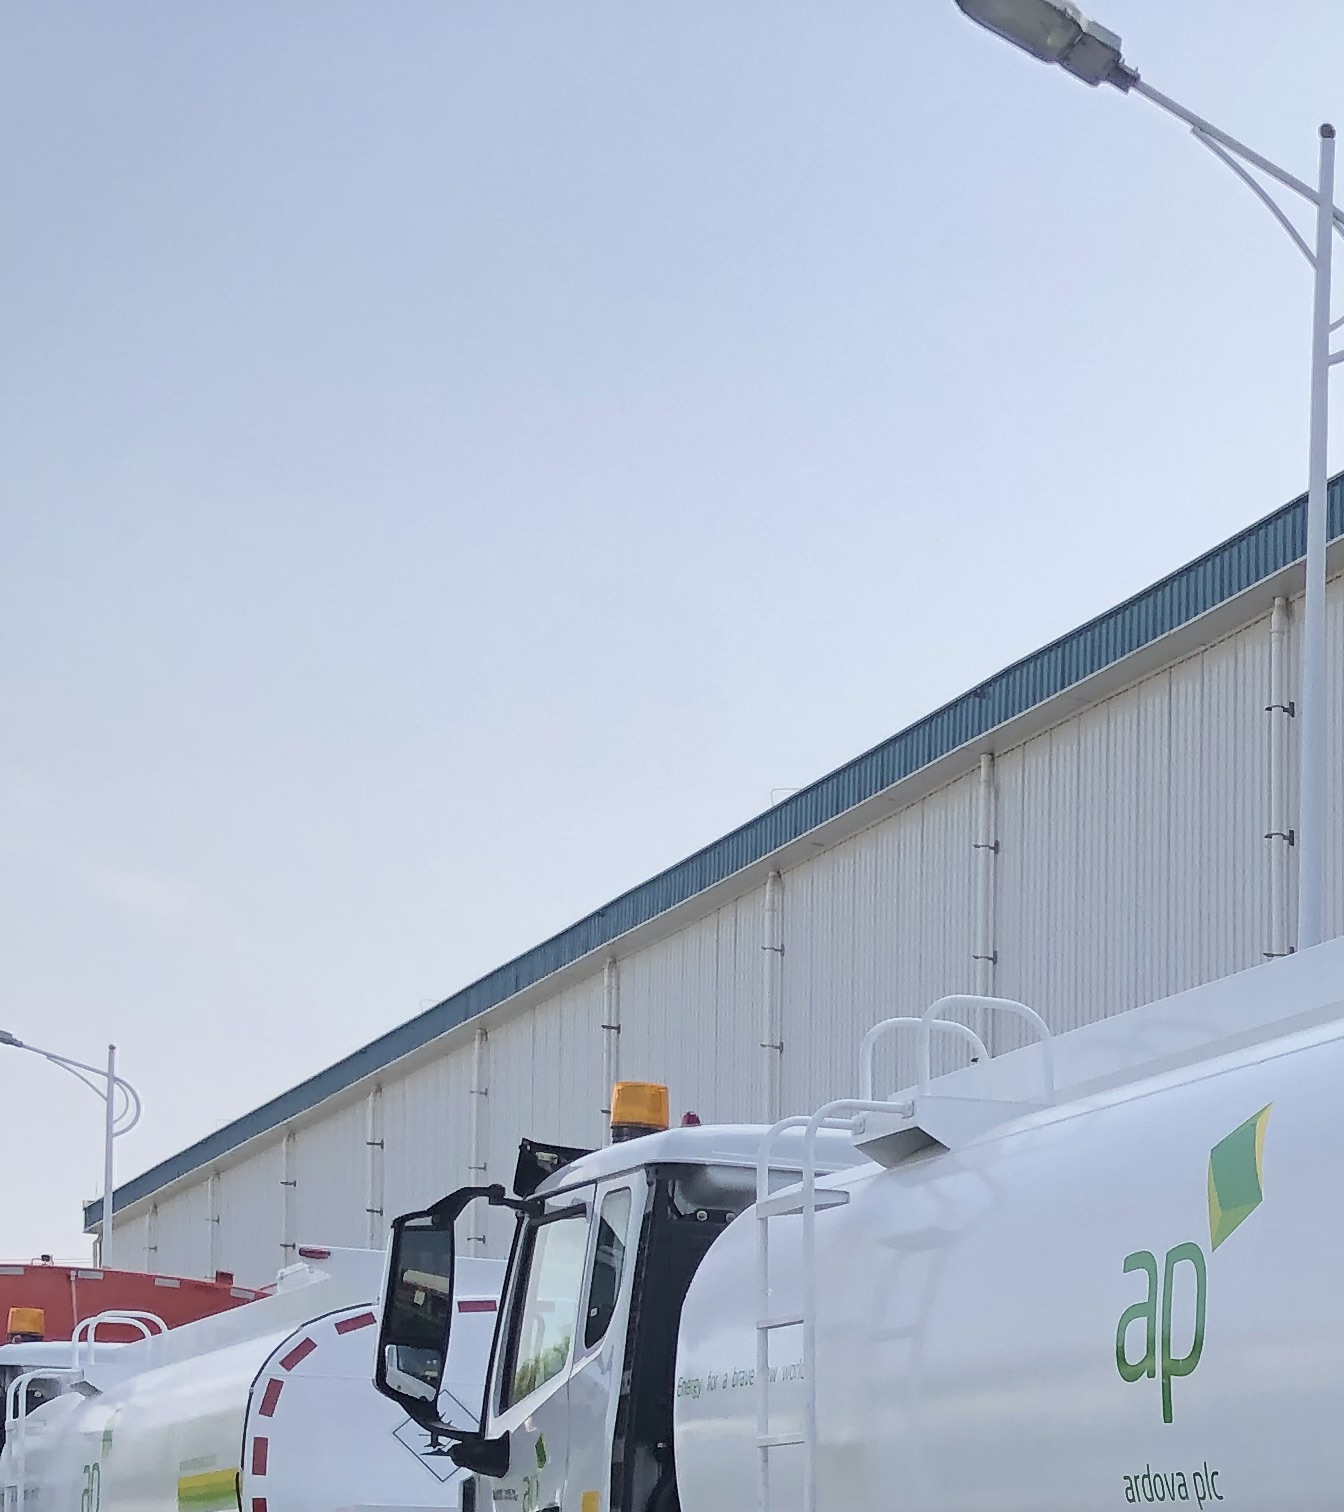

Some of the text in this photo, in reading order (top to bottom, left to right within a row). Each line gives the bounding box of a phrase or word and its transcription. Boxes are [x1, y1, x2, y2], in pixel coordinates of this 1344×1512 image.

[1114, 1241, 1208, 1425] ap
[676, 1376, 703, 1399] Energy
[706, 1370, 719, 1392] for
[721, 1373, 729, 1390] a
[731, 1367, 756, 1388] brave
[1121, 1461, 1225, 1511] ardova plc
